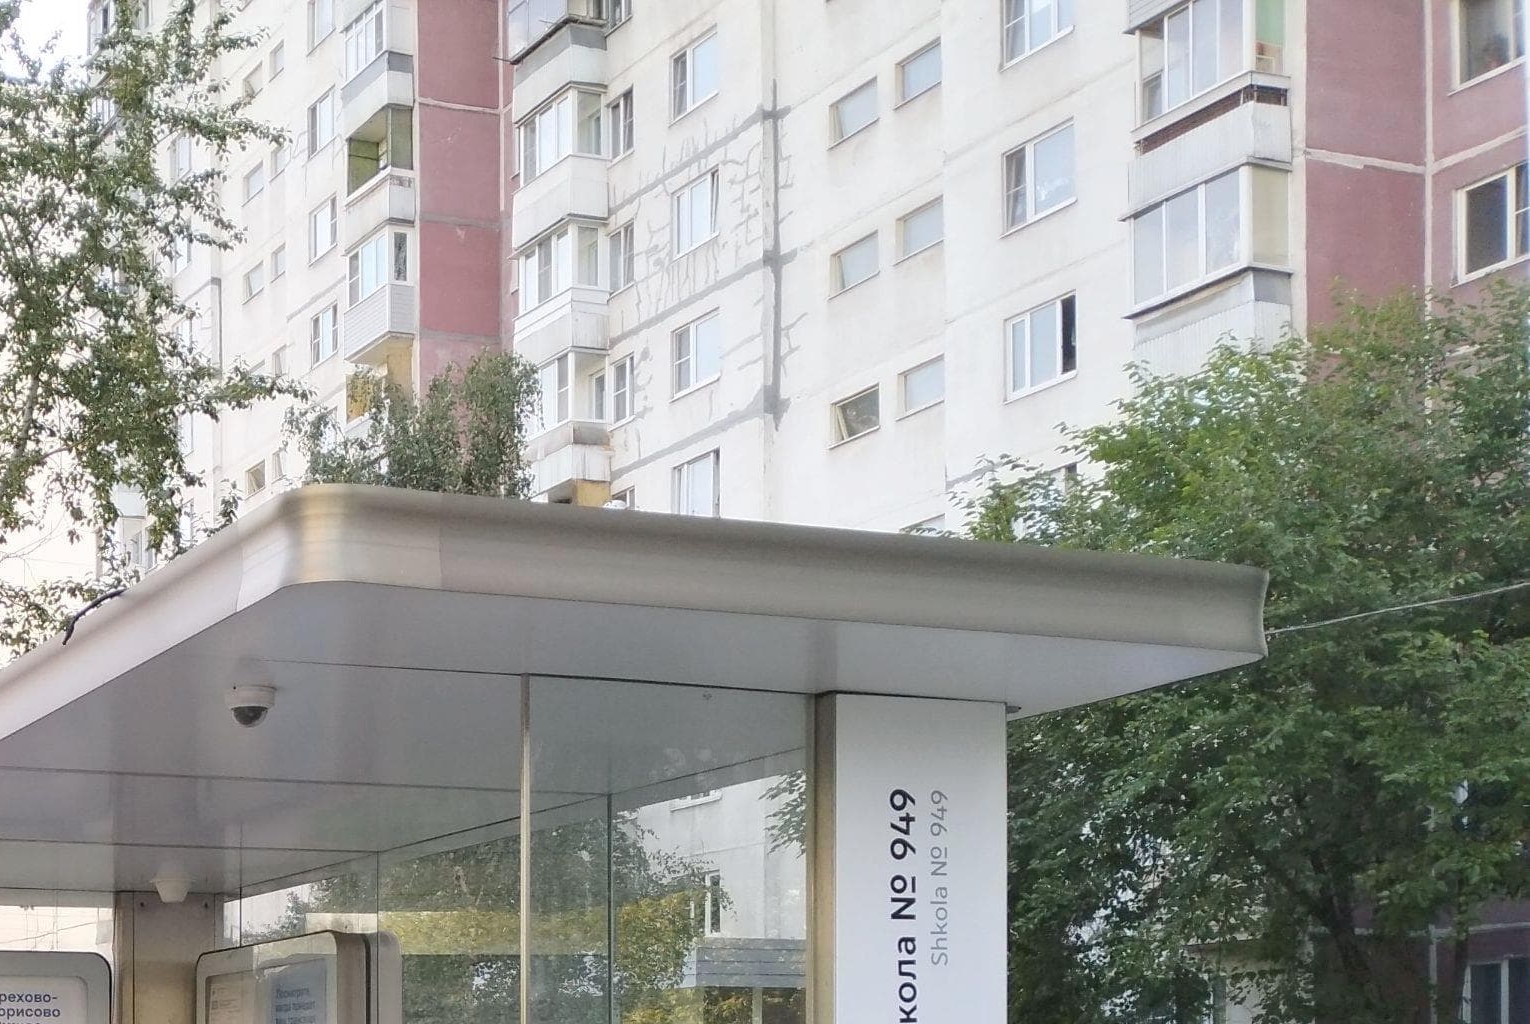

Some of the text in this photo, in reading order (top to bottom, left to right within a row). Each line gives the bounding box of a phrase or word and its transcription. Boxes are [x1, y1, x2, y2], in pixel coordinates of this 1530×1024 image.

[890, 788, 916, 861] 949
[931, 790, 948, 837] 949
[931, 886, 948, 966] Shkola
